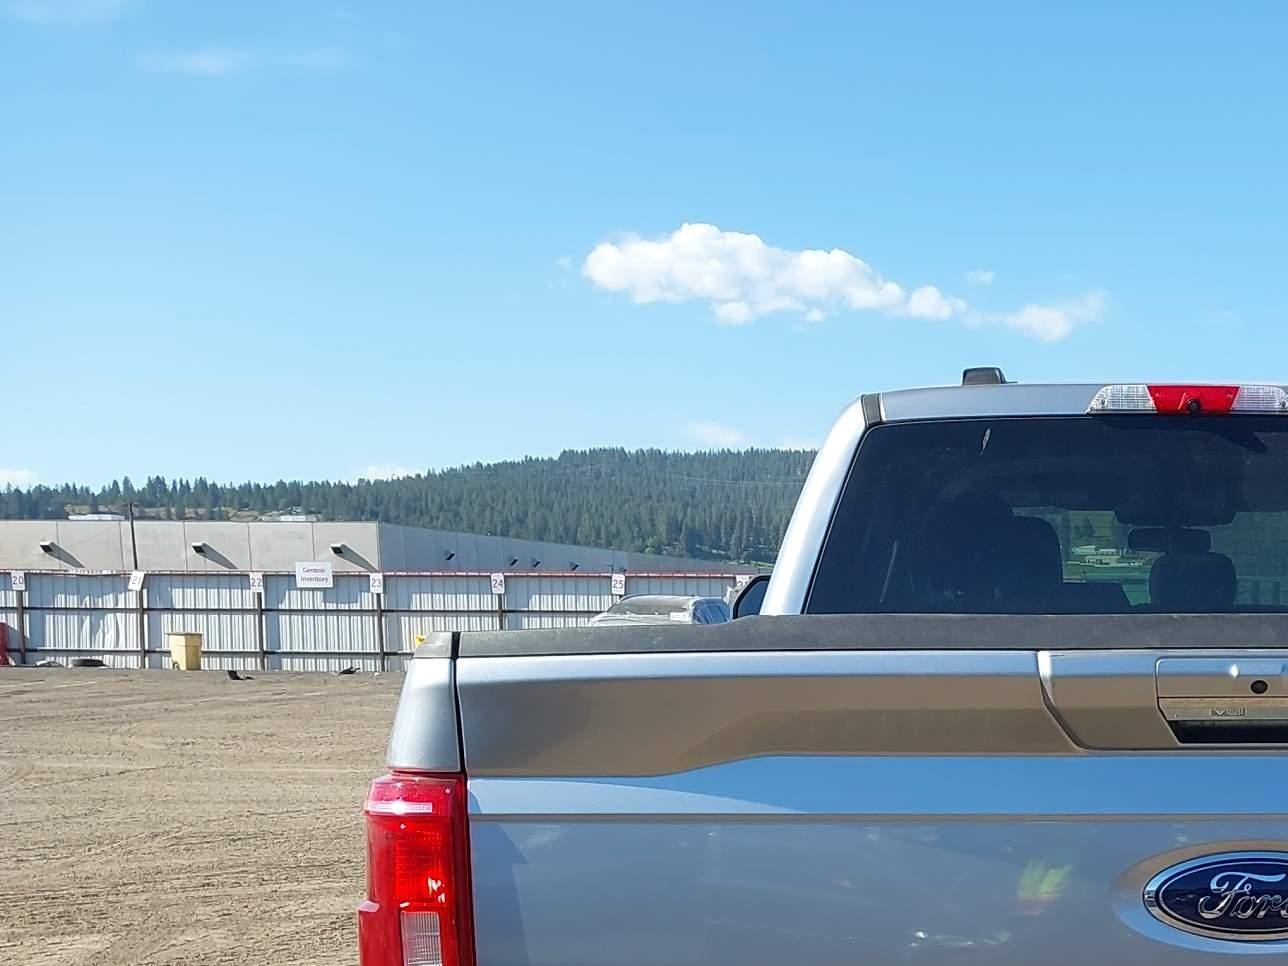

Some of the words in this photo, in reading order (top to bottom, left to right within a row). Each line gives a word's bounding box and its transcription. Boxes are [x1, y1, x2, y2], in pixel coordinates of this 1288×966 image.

[12, 576, 24, 585] 20
[131, 575, 141, 585] 21
[251, 578, 263, 587] 22
[300, 576, 329, 584] Inventory
[371, 578, 382, 588] 23
[493, 580, 503, 589] 24
[612, 580, 624, 589] 25
